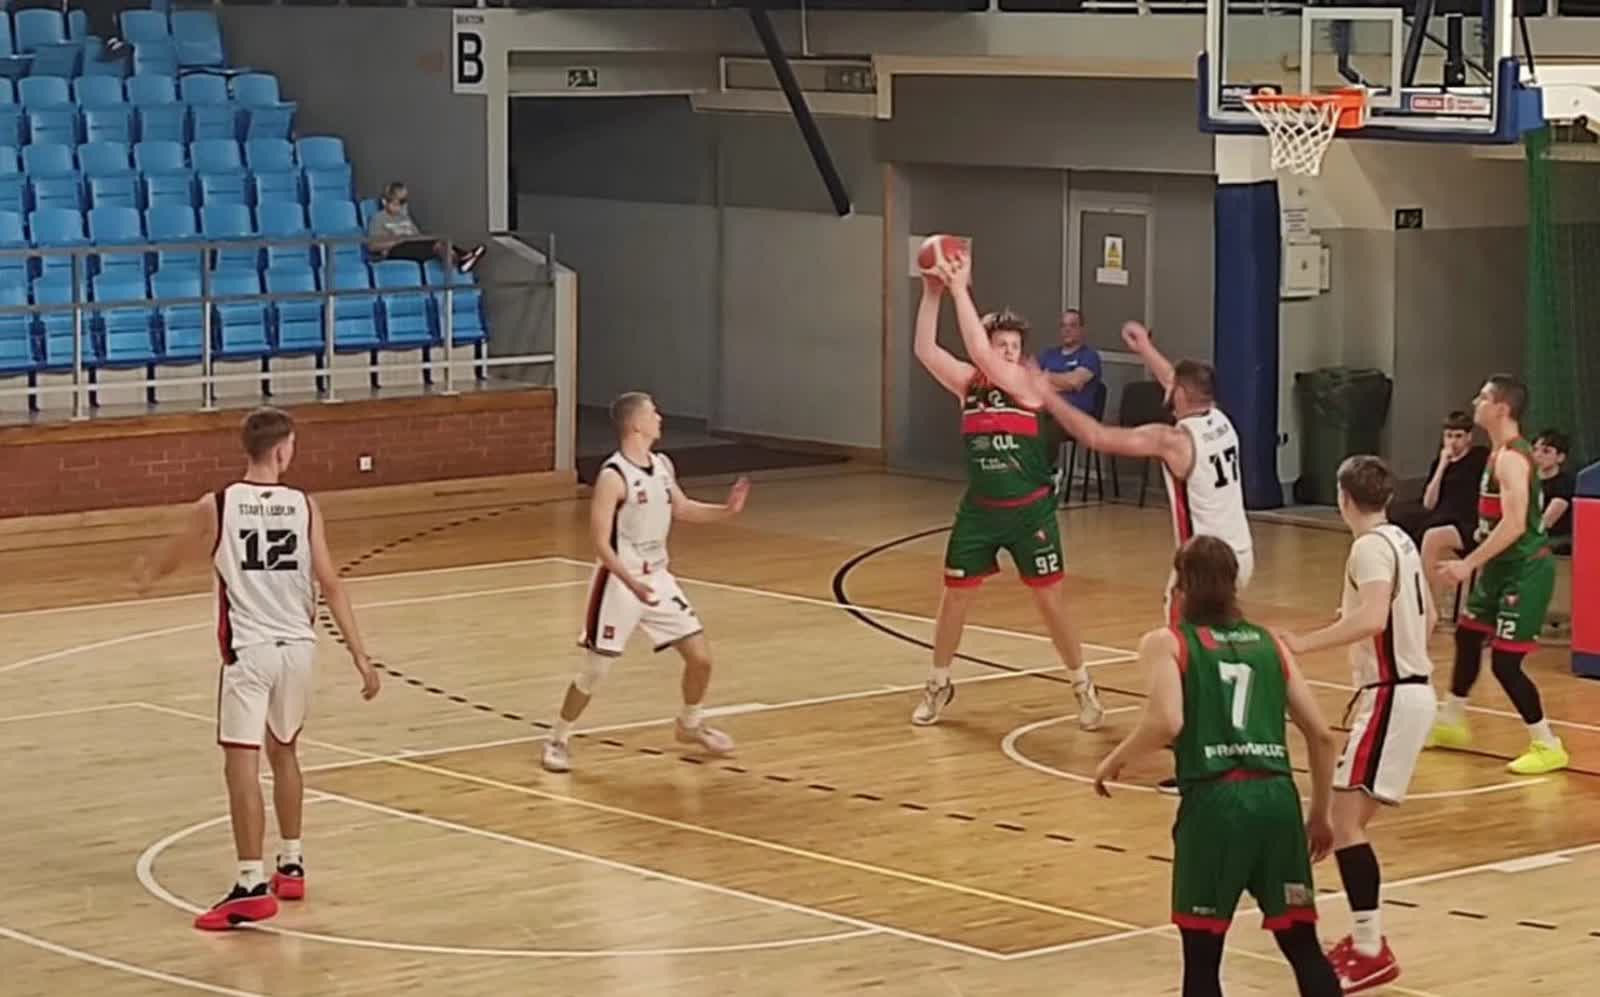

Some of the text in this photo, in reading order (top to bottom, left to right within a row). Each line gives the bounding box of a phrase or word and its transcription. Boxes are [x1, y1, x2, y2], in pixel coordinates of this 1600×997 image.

[457, 31, 484, 84] B
[1209, 445, 1238, 488] 17
[239, 529, 298, 570] 12
[1035, 553, 1059, 575] 92
[1496, 618, 1516, 640] 12
[1218, 660, 1255, 730] 7
